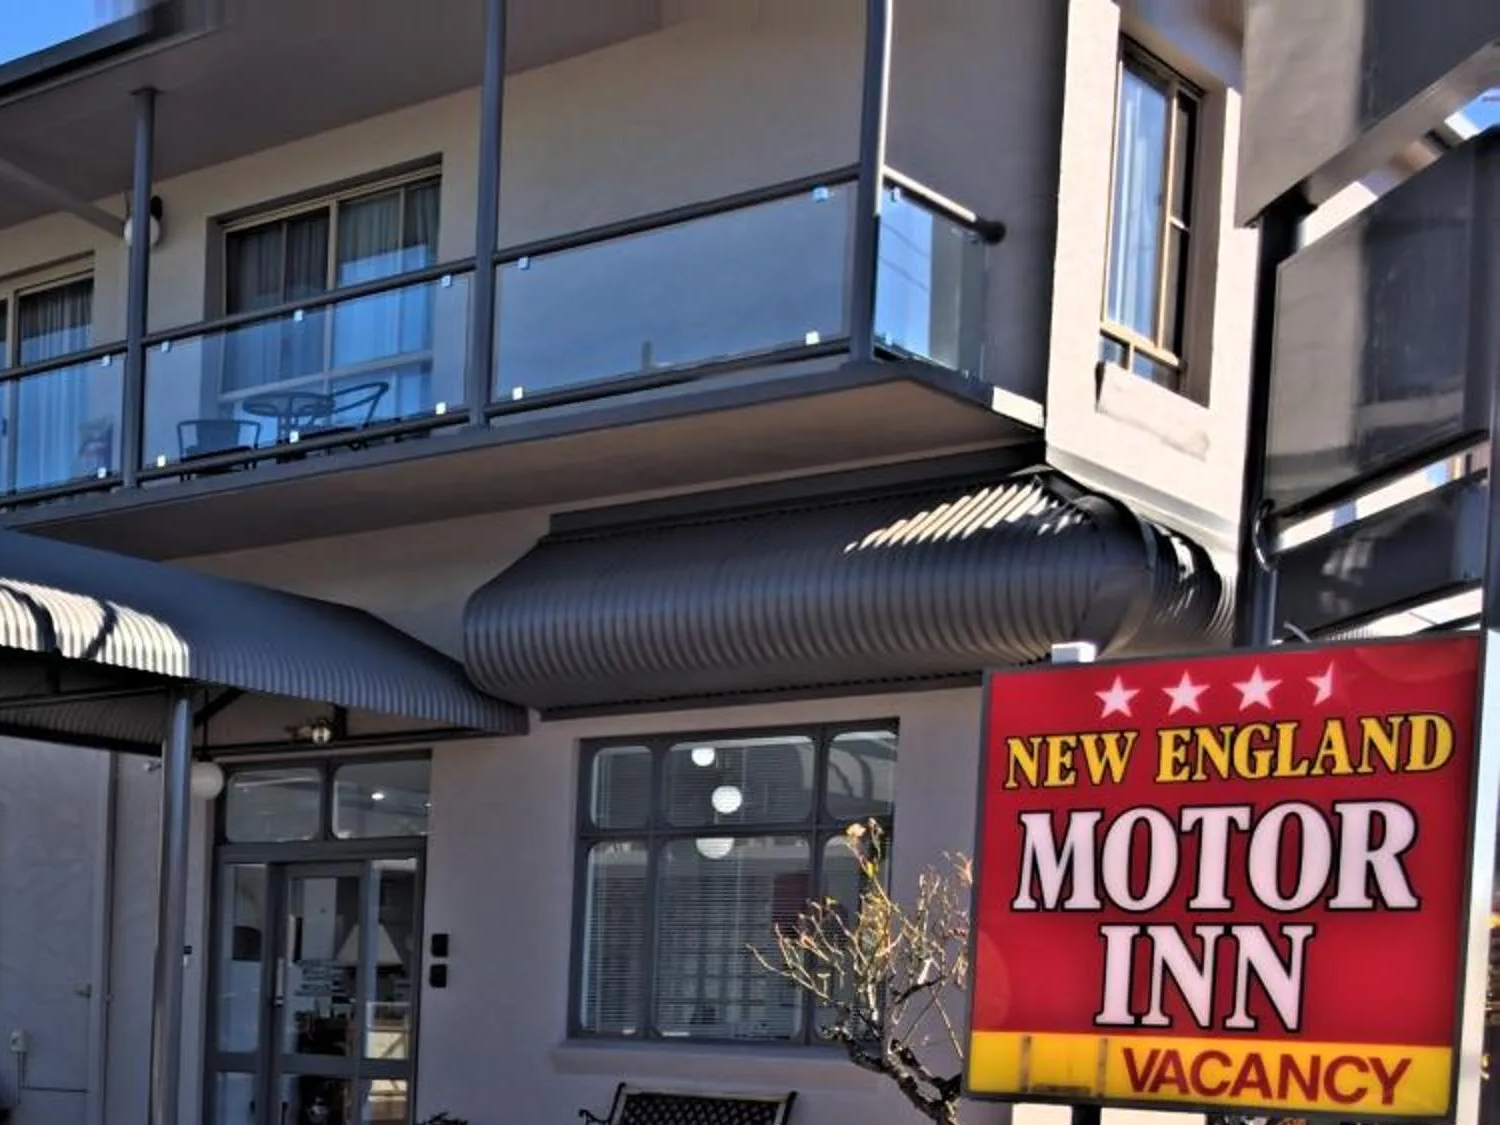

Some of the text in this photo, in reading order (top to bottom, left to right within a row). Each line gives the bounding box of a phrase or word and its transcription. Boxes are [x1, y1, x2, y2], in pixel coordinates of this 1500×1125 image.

[1004, 713, 1455, 789] NEW ENGLAND
[1011, 800, 1421, 913] MOTOR
[1094, 922, 1315, 1032] INN
[1123, 1048, 1412, 1105] VACANCY
